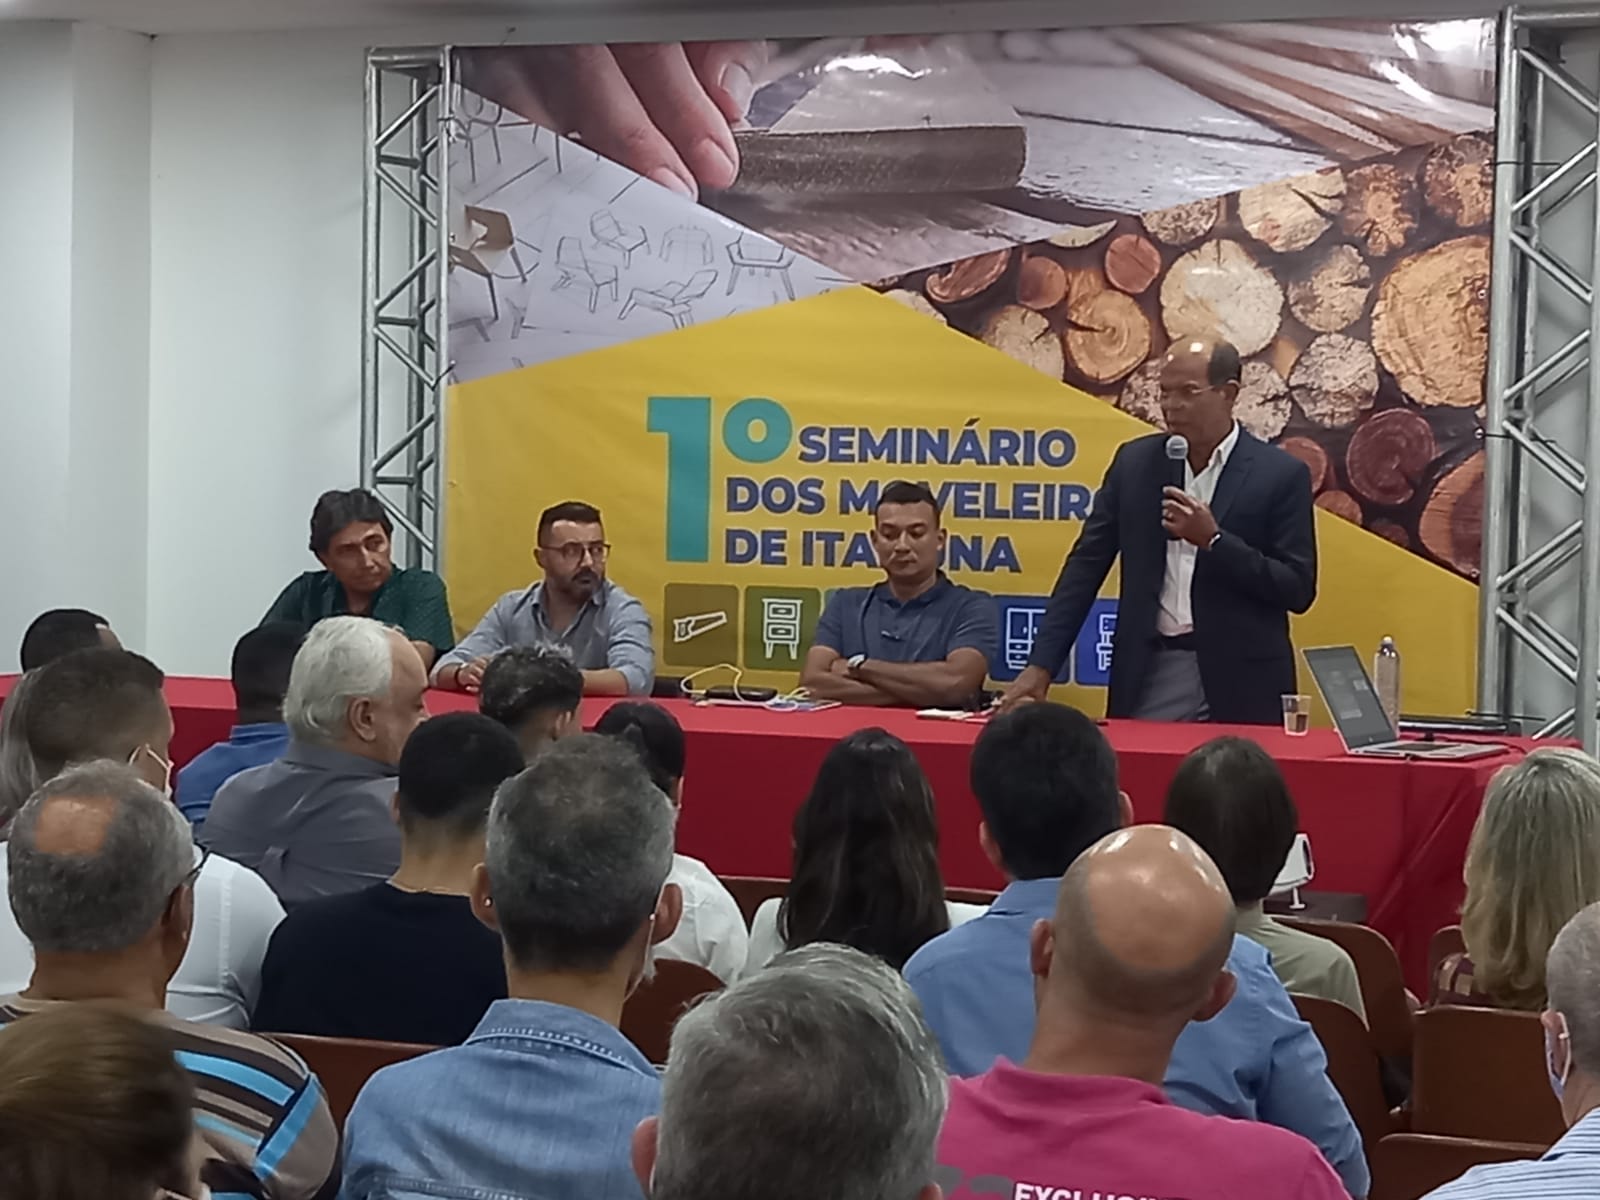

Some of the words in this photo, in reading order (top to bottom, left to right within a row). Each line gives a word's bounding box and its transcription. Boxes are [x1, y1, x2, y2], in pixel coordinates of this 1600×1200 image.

[798, 417, 1076, 467] SEMINÁRIO
[726, 477, 826, 514] DOS
[726, 529, 788, 565] DE
[802, 531, 1021, 573] ITANA
